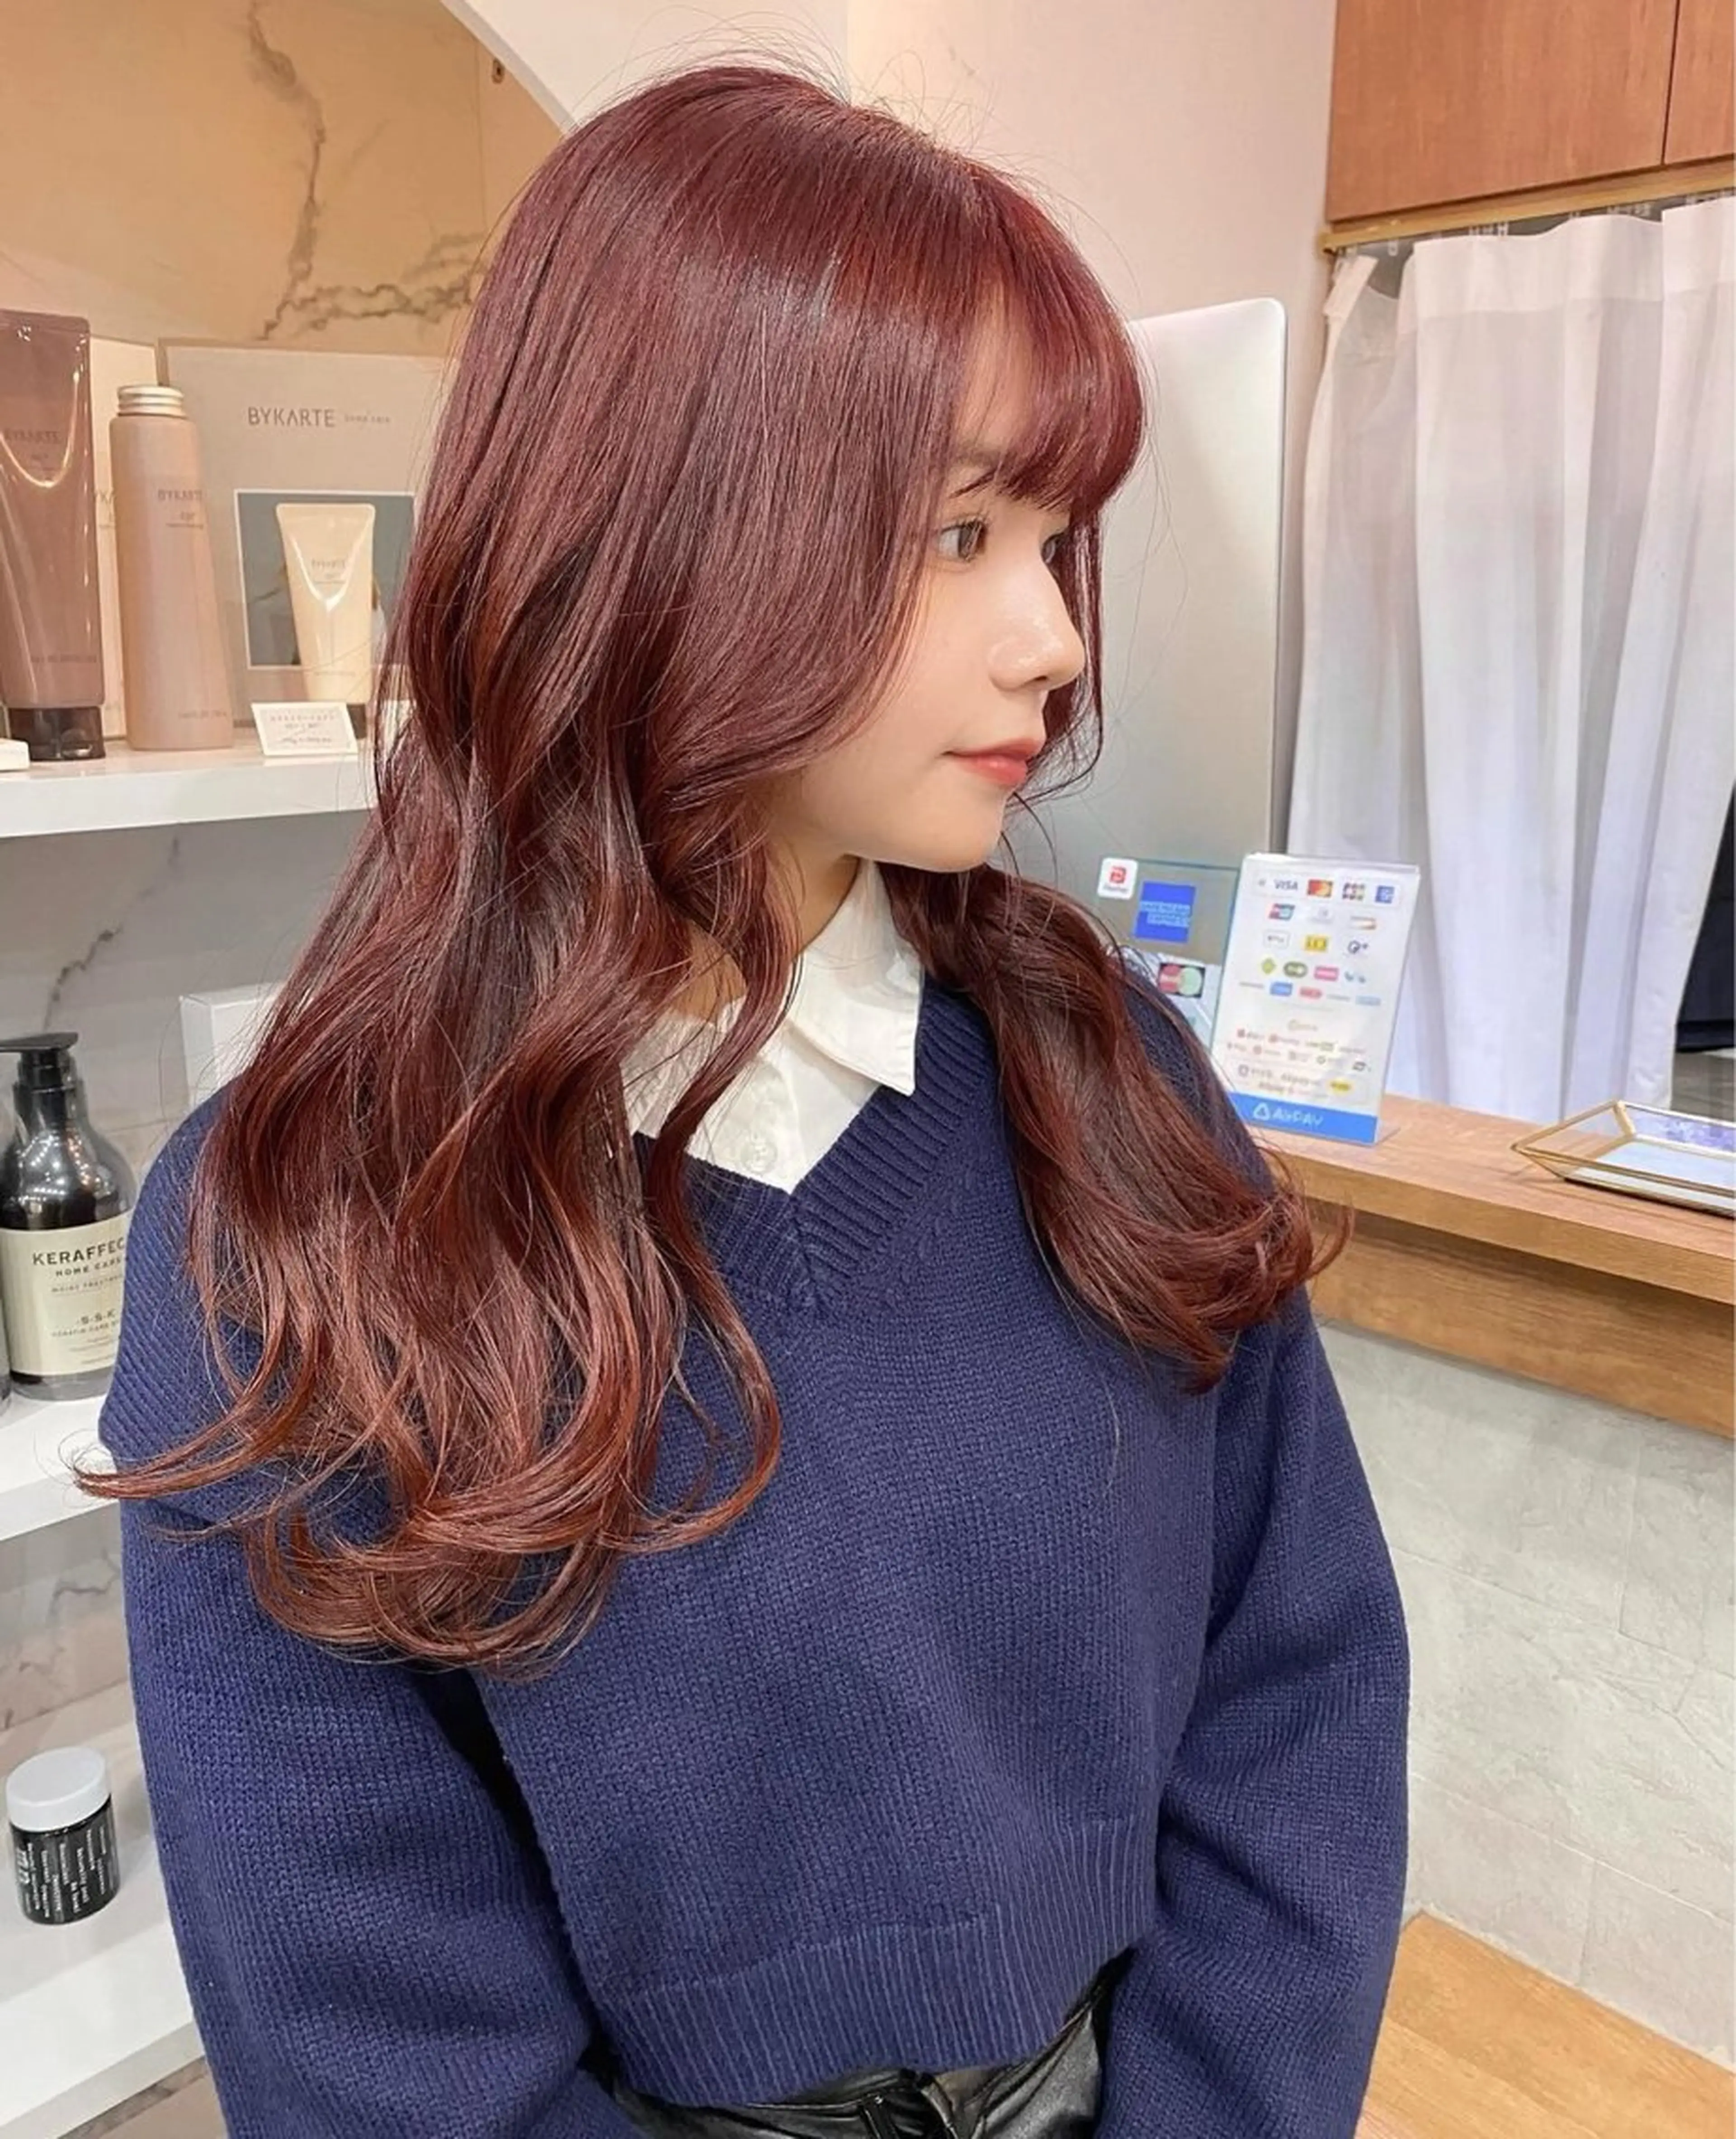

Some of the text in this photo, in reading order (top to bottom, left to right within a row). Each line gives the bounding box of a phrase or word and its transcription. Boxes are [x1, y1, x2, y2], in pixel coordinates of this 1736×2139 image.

[248, 406, 335, 428] BYKARTE
[1274, 879, 1298, 891] VISA
[56, 1266, 89, 1277] HOME
